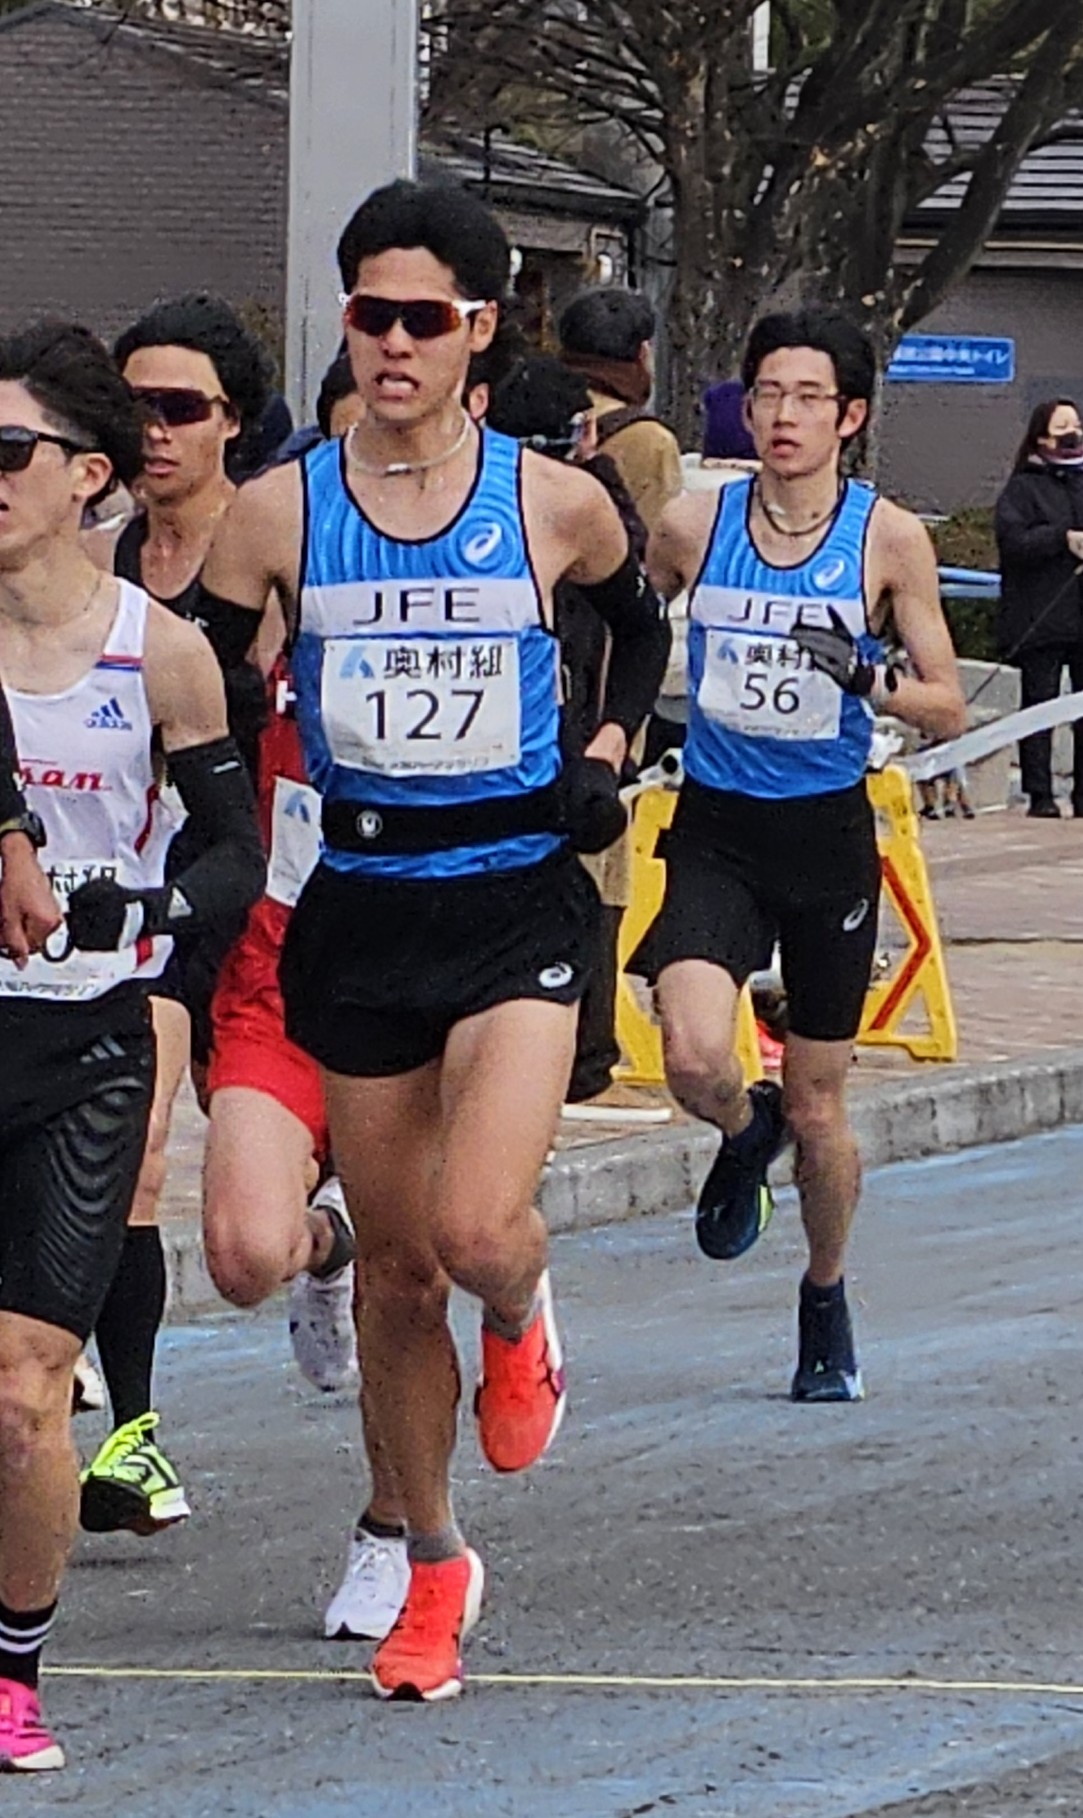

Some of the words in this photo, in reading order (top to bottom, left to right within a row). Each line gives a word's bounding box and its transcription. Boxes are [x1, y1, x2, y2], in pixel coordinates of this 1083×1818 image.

[352, 588, 480, 625] JFE
[728, 598, 823, 628] JFE
[384, 646, 503, 680] 奥村組
[743, 642, 816, 672] 奥村
[740, 672, 800, 715] 56
[365, 689, 485, 741] 127
